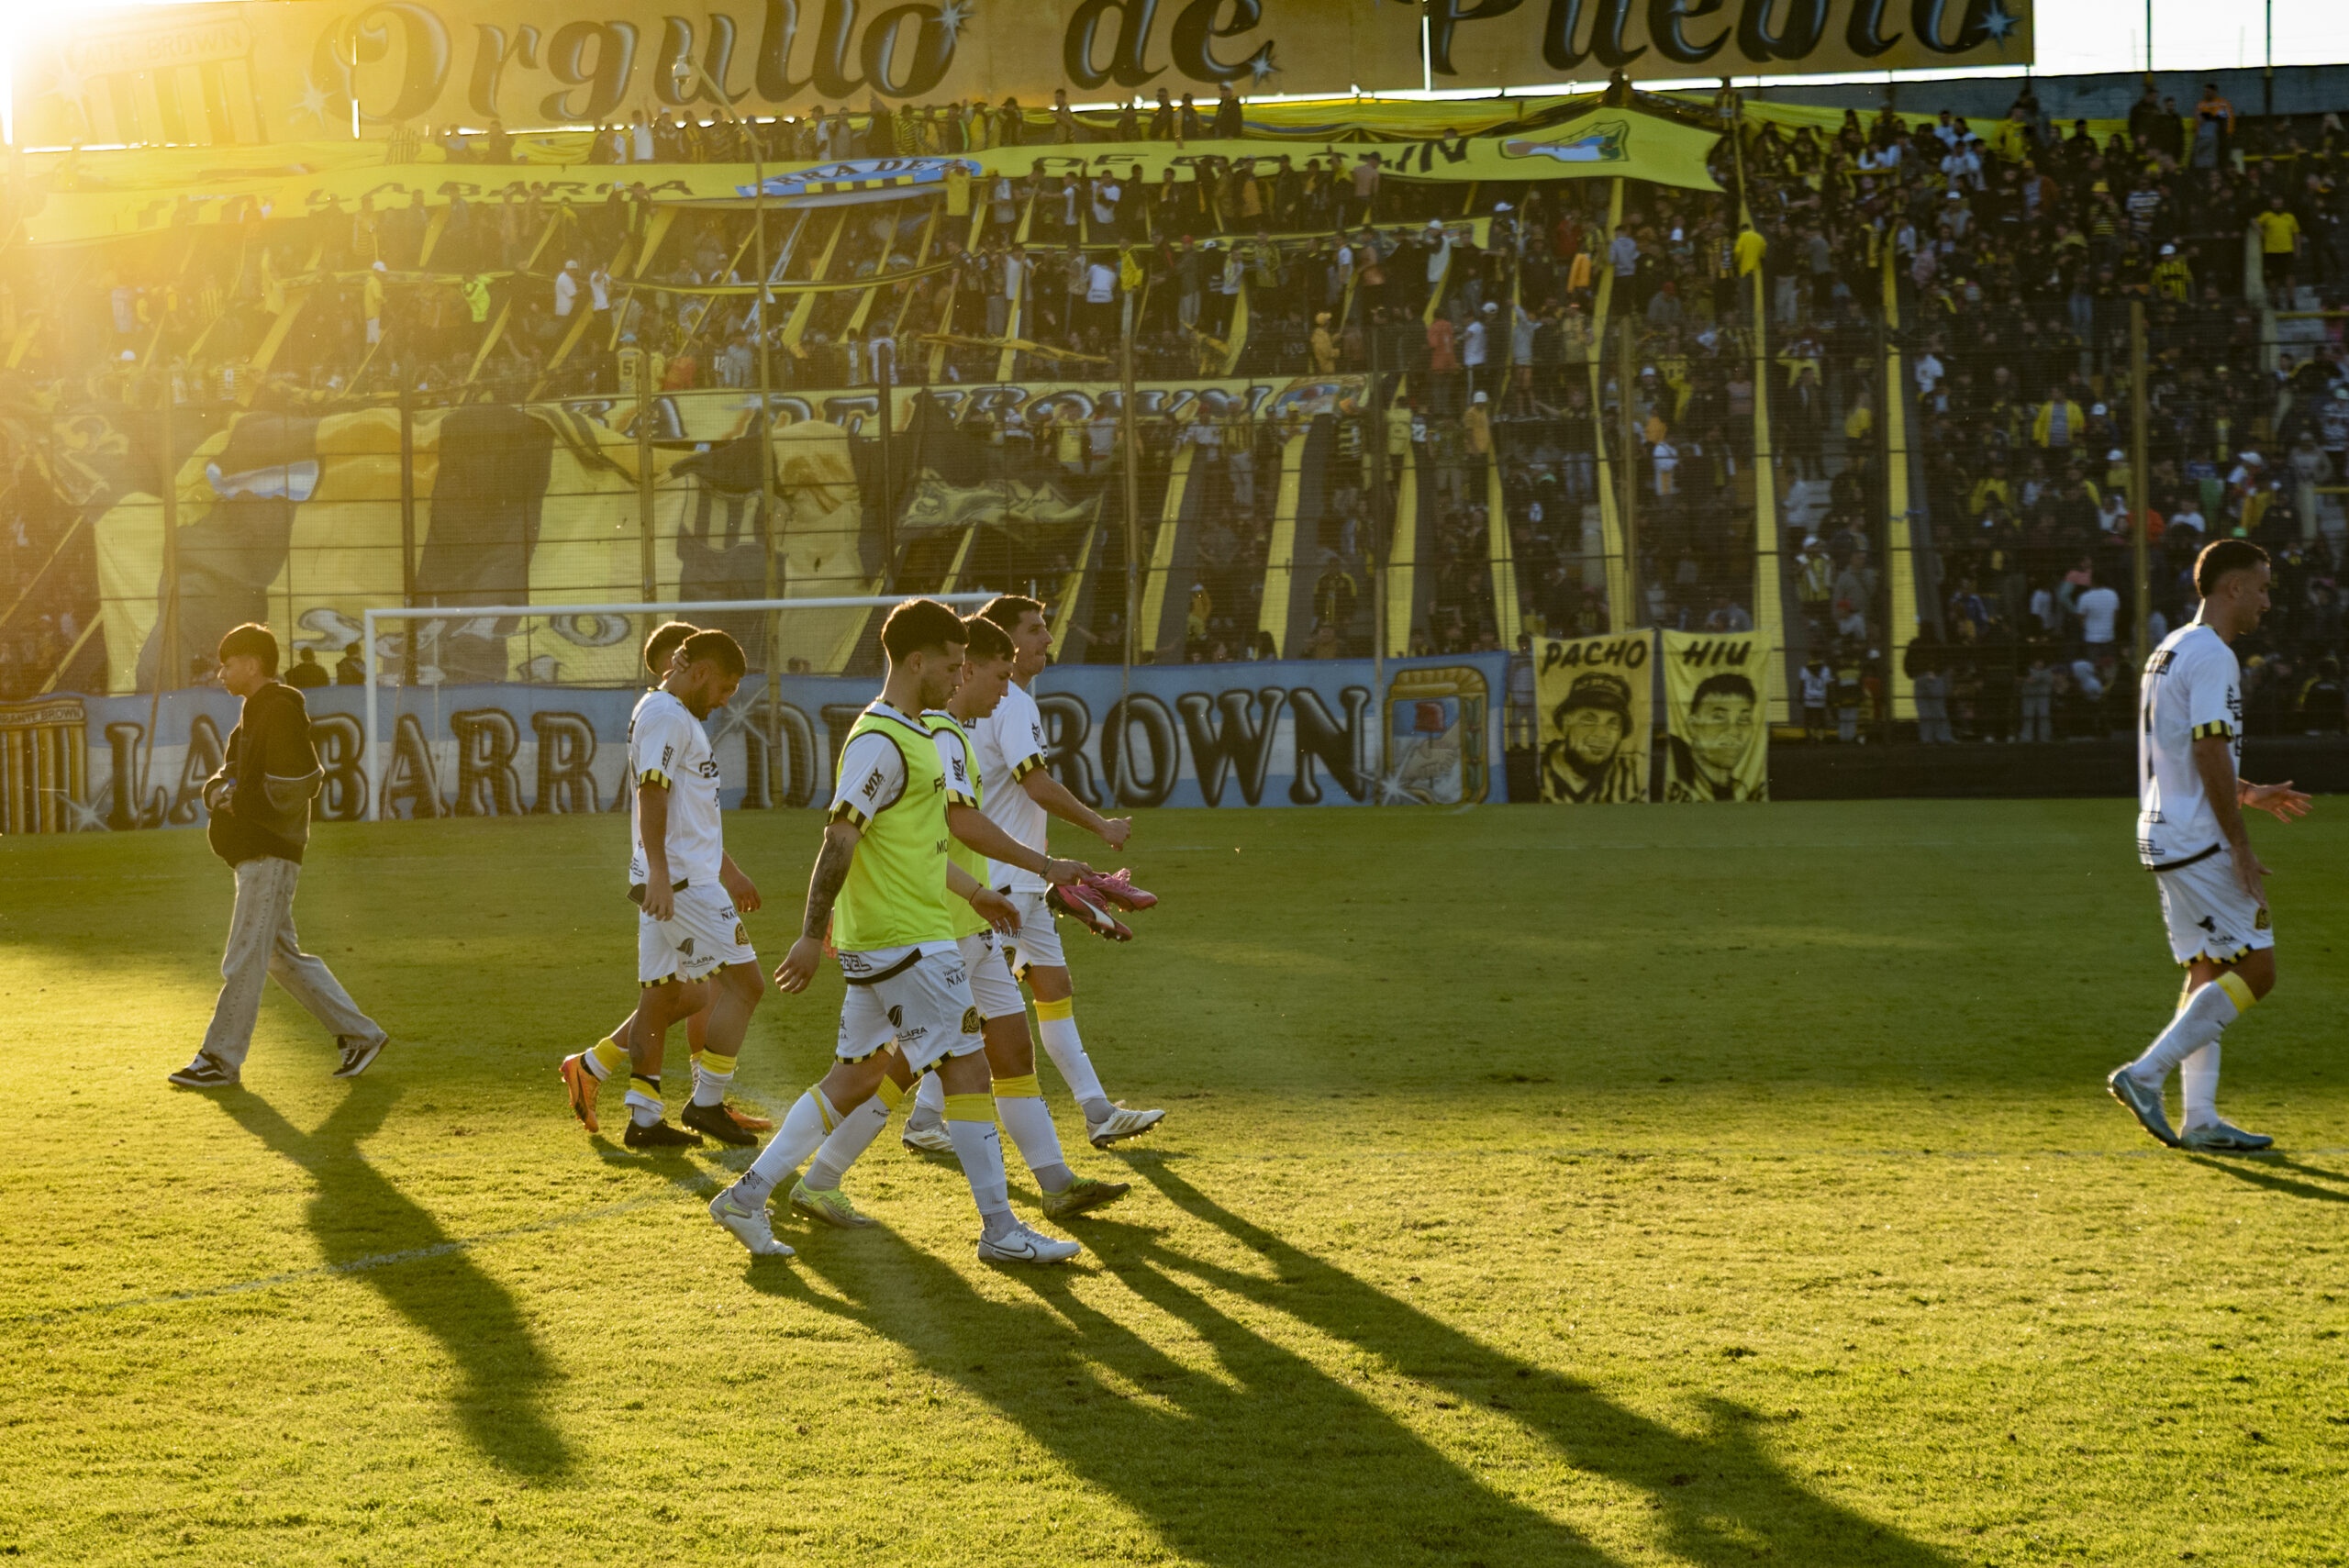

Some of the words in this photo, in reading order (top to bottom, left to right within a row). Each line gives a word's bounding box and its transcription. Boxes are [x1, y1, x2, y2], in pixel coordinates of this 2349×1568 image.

[147, 27, 241, 61] BROWN
[312, 0, 960, 124] Orgullo
[1063, 0, 1275, 89] de
[1541, 639, 1648, 677] PACHO
[1682, 640, 1753, 667] HIU
[310, 706, 635, 822] BARR
[1037, 685, 1372, 809] ROWN
[952, 756, 964, 783] WIX
[862, 767, 885, 798] WIX
